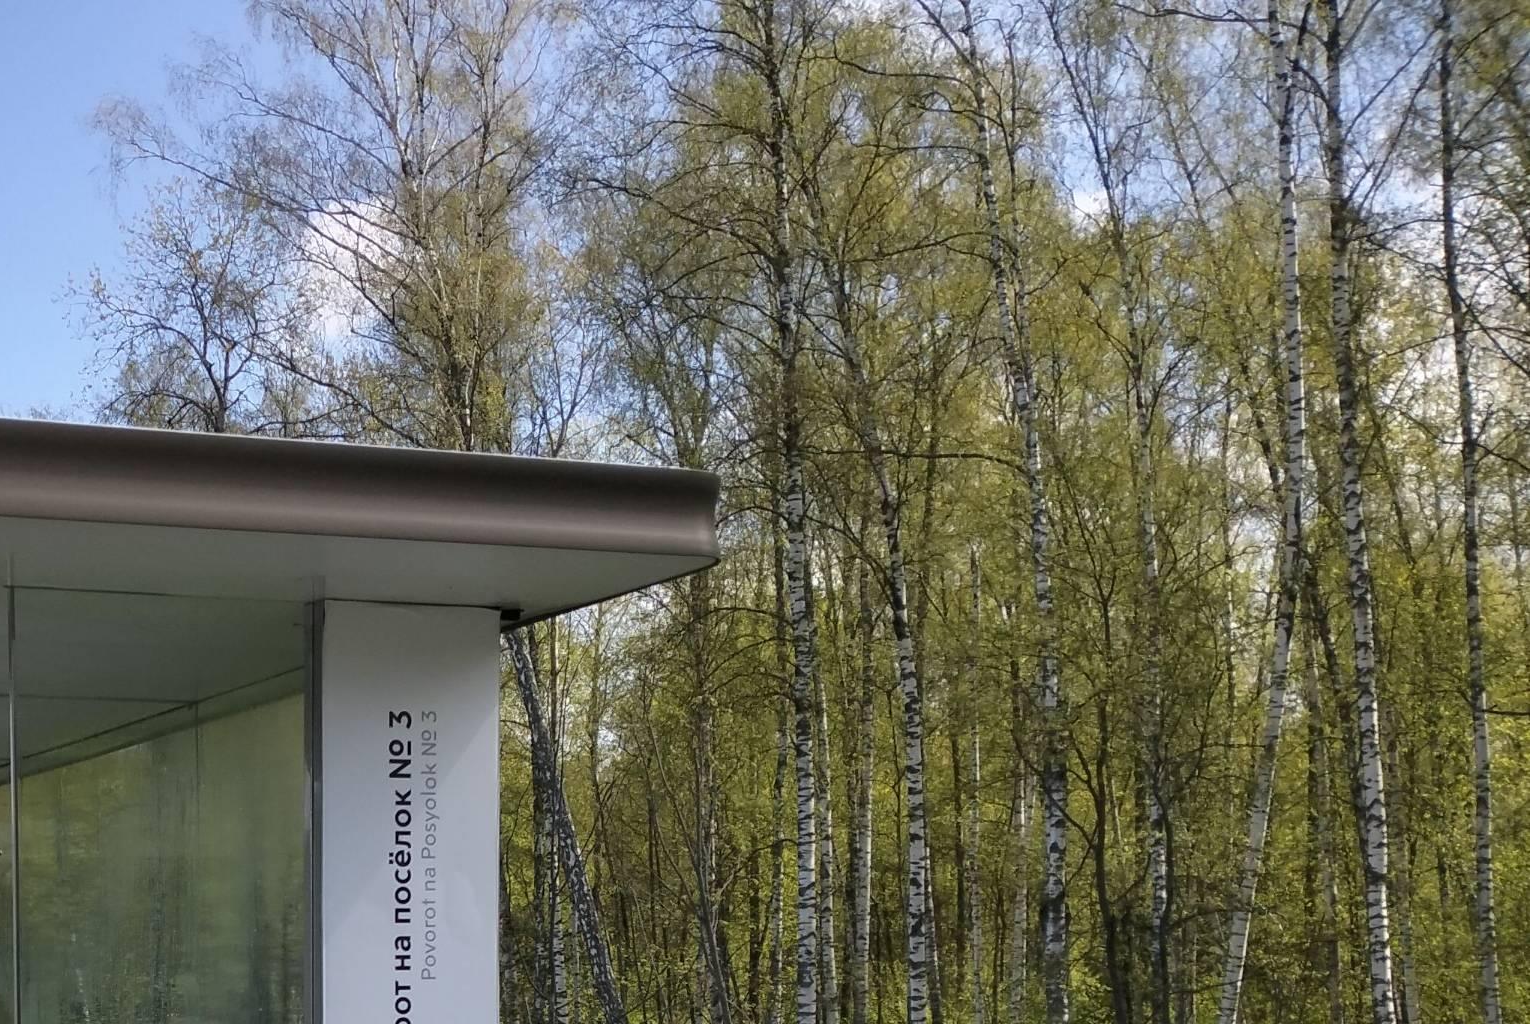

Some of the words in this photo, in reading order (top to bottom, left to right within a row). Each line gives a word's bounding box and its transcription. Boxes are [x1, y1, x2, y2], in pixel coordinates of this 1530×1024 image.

[389, 711, 412, 728] 3
[421, 711, 436, 723] 3
[388, 739, 412, 778] №
[421, 730, 437, 756] №
[421, 763, 440, 859] Posyolok
[389, 790, 412, 924] посёлок
[425, 867, 436, 891] na
[394, 936, 412, 971] на
[421, 899, 436, 979] Povorot
